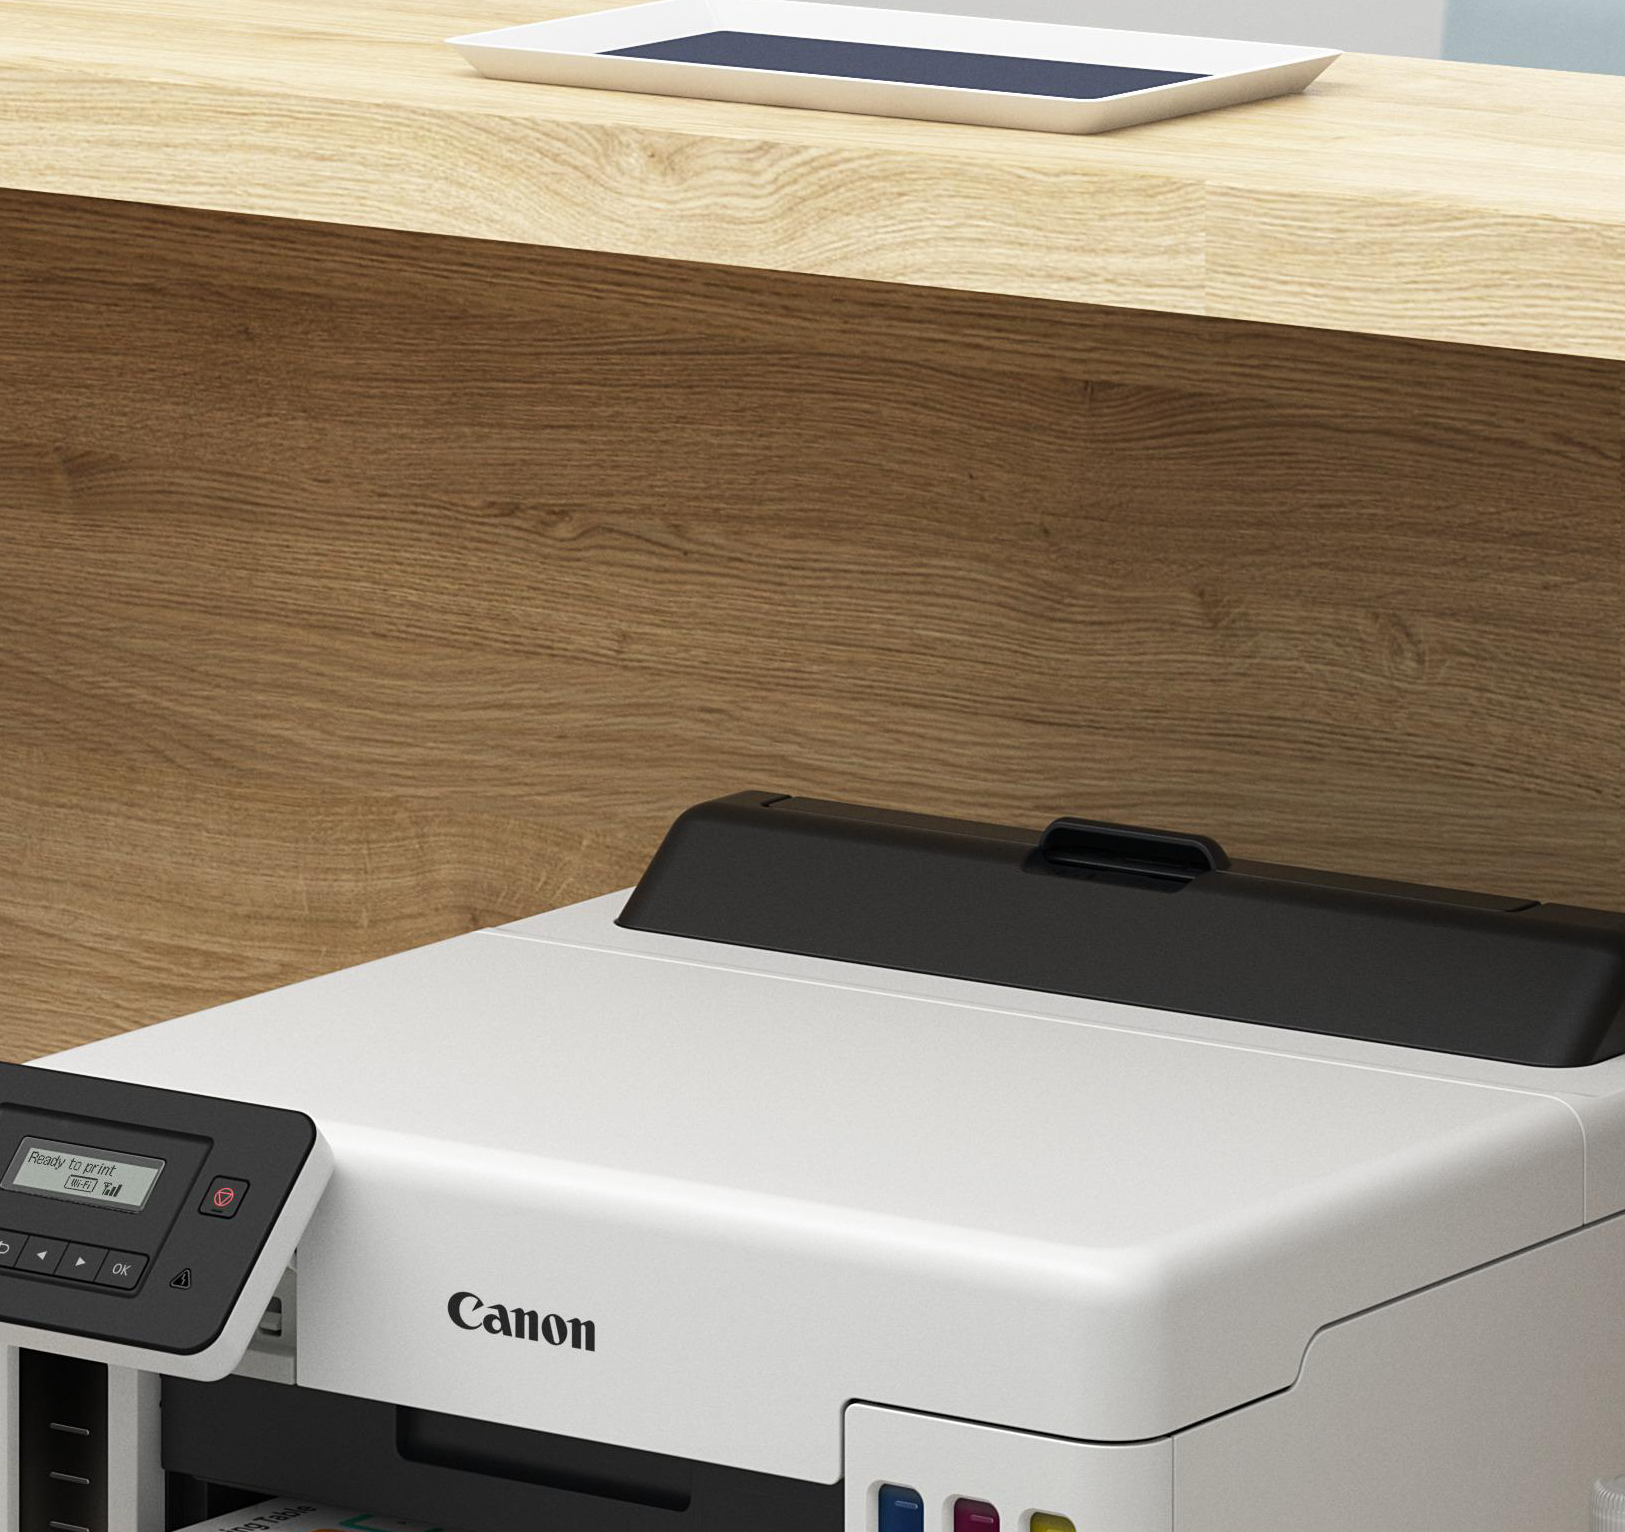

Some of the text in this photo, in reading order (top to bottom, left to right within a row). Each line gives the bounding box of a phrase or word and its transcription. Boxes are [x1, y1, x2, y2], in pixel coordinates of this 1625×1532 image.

[27, 1151, 117, 1178] Ready to print
[70, 1178, 93, 1192] Wi-Fi
[111, 1262, 131, 1277] OK
[447, 1291, 596, 1352] Canon
[257, 1504, 318, 1525] Table
